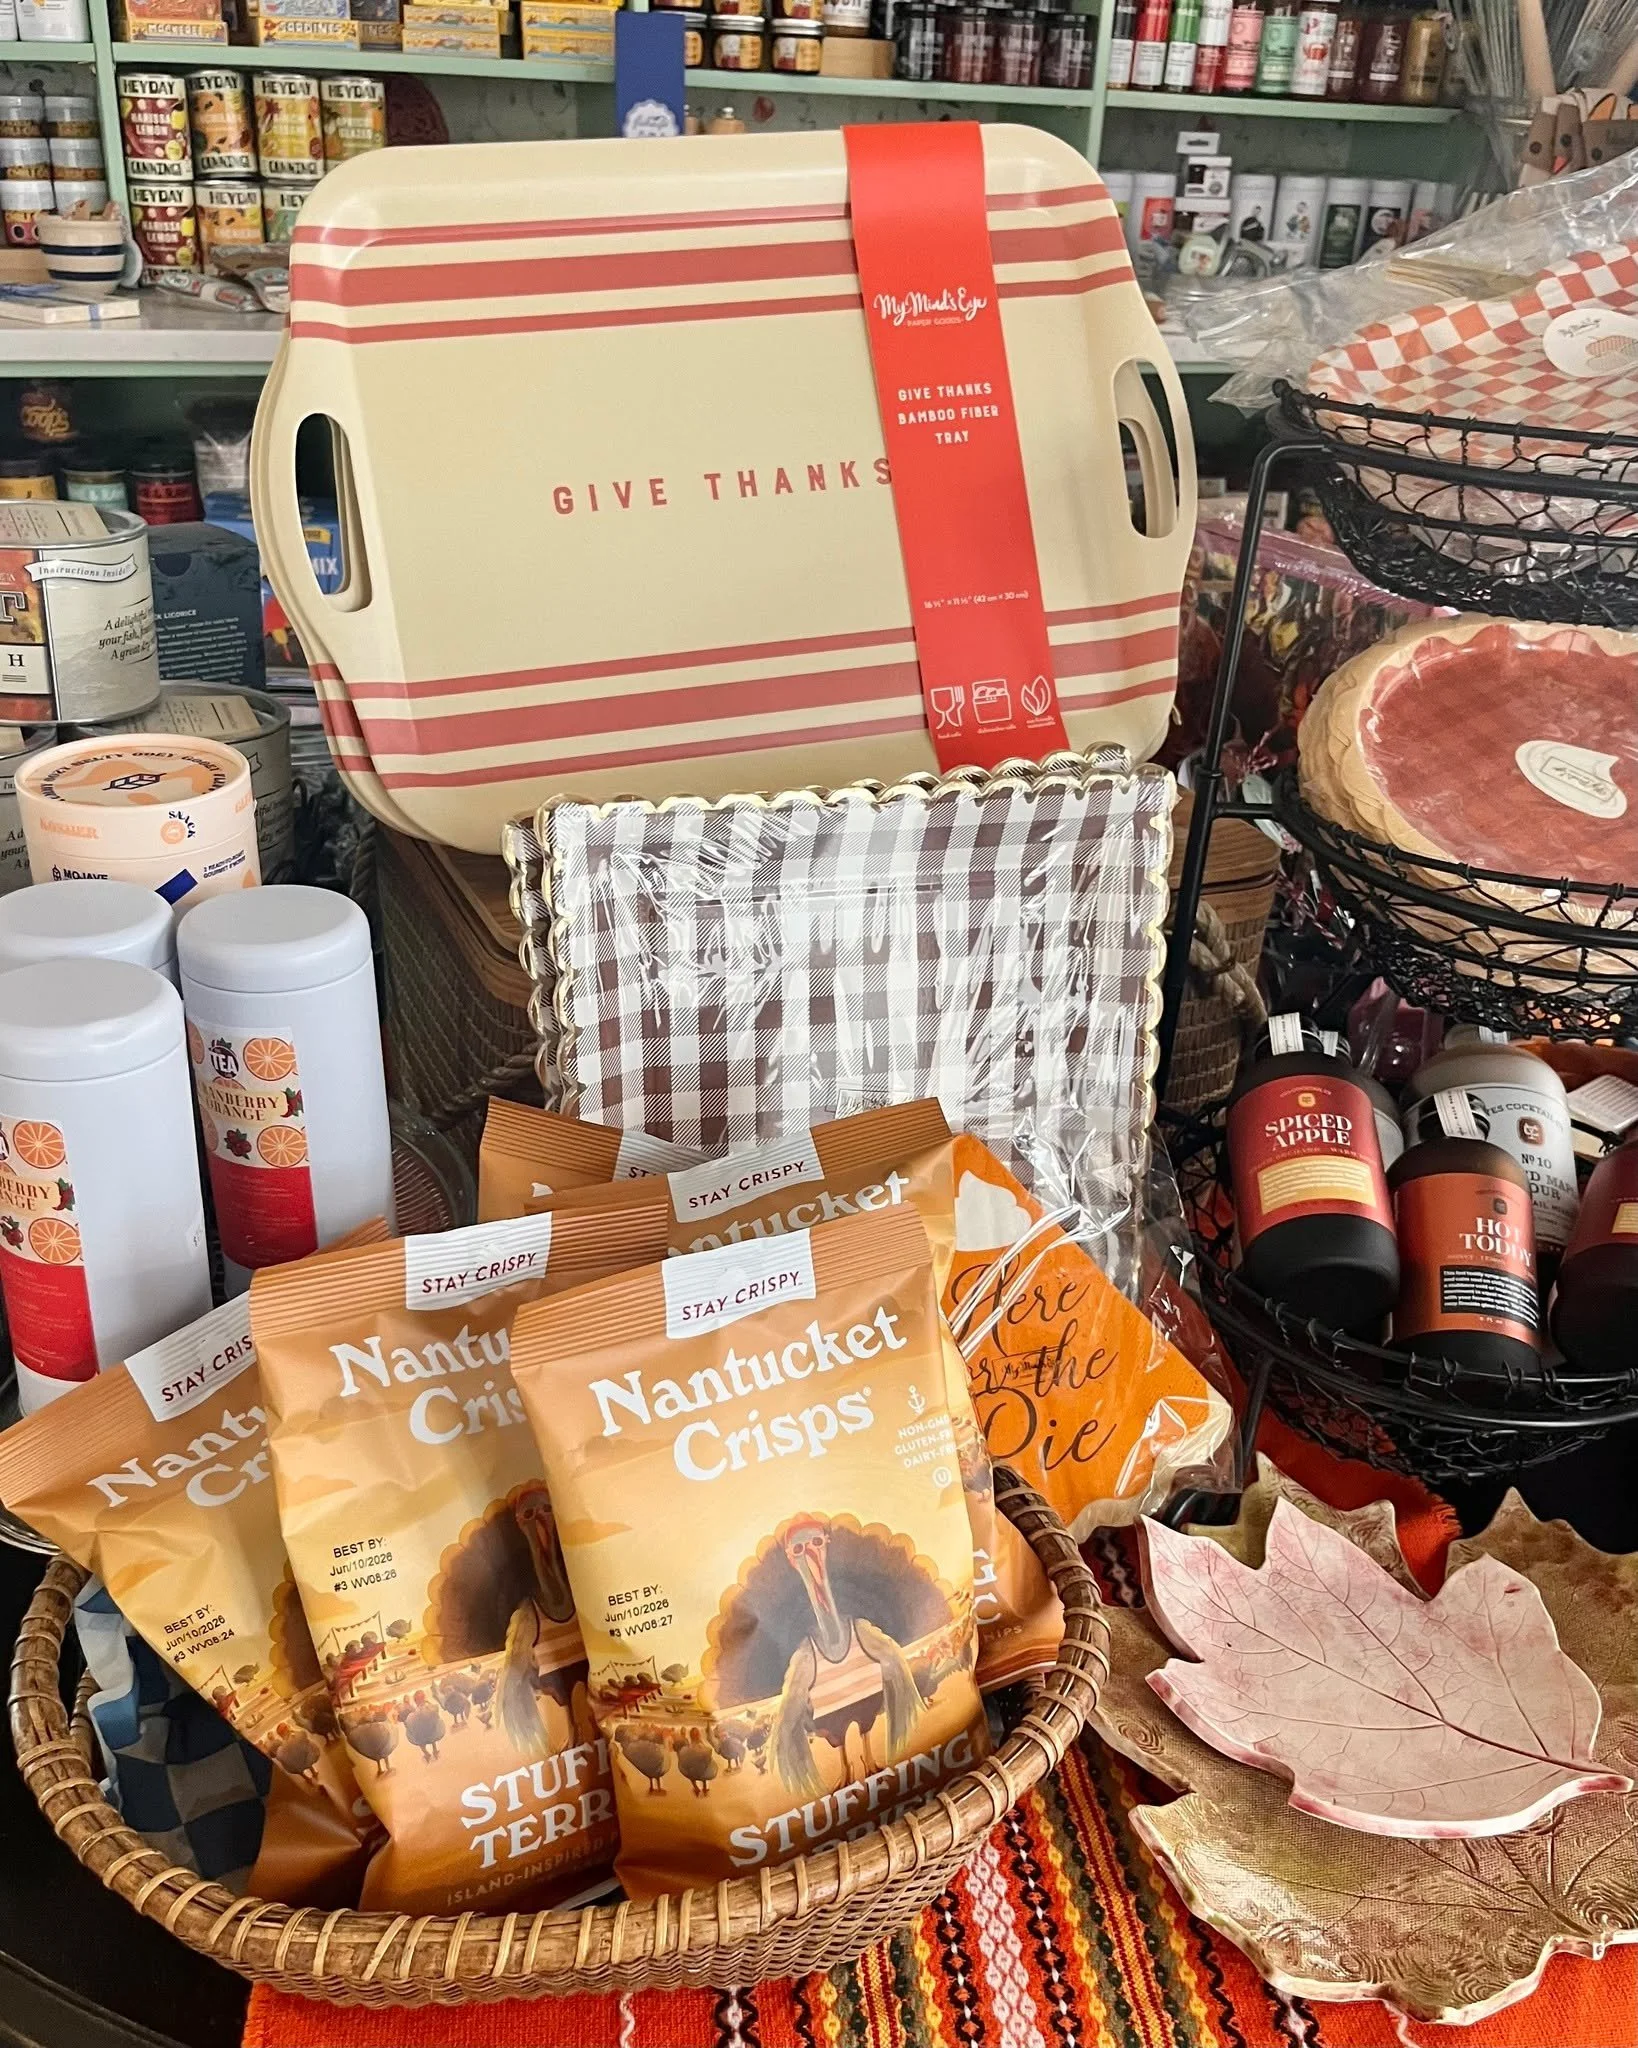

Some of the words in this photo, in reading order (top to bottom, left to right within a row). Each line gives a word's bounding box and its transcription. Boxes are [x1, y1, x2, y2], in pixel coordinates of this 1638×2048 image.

[123, 80, 174, 94] HEYDAY
[190, 76, 239, 91] HEYDAY
[262, 80, 311, 95] HEYDAY
[328, 84, 377, 98] HEYDAY
[135, 124, 168, 135] LEMON
[133, 189, 184, 203] HEYDAY
[209, 191, 258, 204] HEYDAY
[280, 193, 305, 207] HEY
[147, 233, 179, 243] LEMON
[905, 288, 957, 317] Mind's
[957, 287, 988, 321] Eye
[898, 387, 931, 401] GIVE
[937, 382, 992, 398] THANKS
[898, 408, 956, 425] BAMBOO
[961, 404, 999, 419] FIBER
[935, 430, 969, 444] TRAY
[553, 477, 668, 515] GIVE
[704, 458, 892, 501] THANKS
[104, 619, 112, 630] A
[163, 608, 197, 620] LICORICE
[98, 635, 122, 650] your
[111, 649, 119, 660] A
[209, 1050, 239, 1073] TEA
[1265, 1113, 1353, 1138] SPICED
[1272, 1130, 1351, 1151] APPLE
[1537, 1157, 1552, 1169] 10
[0, 1176, 52, 1200] BERRY
[689, 1186, 731, 1209] STAY
[739, 1161, 804, 1190] CRISPY
[1530, 1183, 1561, 1200] OUR
[668, 1169, 912, 1256] ntucket
[1458, 1232, 1532, 1267] TODDY
[421, 1271, 471, 1294] STAY
[475, 1252, 537, 1282] CRISPY
[682, 1295, 729, 1322] STAY
[734, 1271, 800, 1305] CRISPY
[951, 1252, 1090, 1358] Here
[161, 1366, 206, 1402] STAY
[212, 1335, 253, 1372] CRIS
[329, 1324, 511, 1398] Nantu
[1023, 1318, 1118, 1398] the
[588, 1305, 908, 1437] Nantucket
[409, 1380, 527, 1445] Cris
[333, 1541, 365, 1558] BEST
[367, 1536, 388, 1550] BY:
[333, 1580, 348, 1592] #3
[607, 1589, 639, 1606] BEST
[642, 1583, 664, 1598] BY:
[164, 1614, 194, 1634] BEST
[195, 1604, 216, 1619] BY:
[604, 1598, 669, 1623] Jun/10/2026
[166, 1614, 226, 1651] Jun/10/2026
[609, 1628, 621, 1637] #3
[173, 1650, 186, 1663] #3
[728, 1731, 974, 1869] STUFFING
[469, 1788, 614, 1869] TERR
